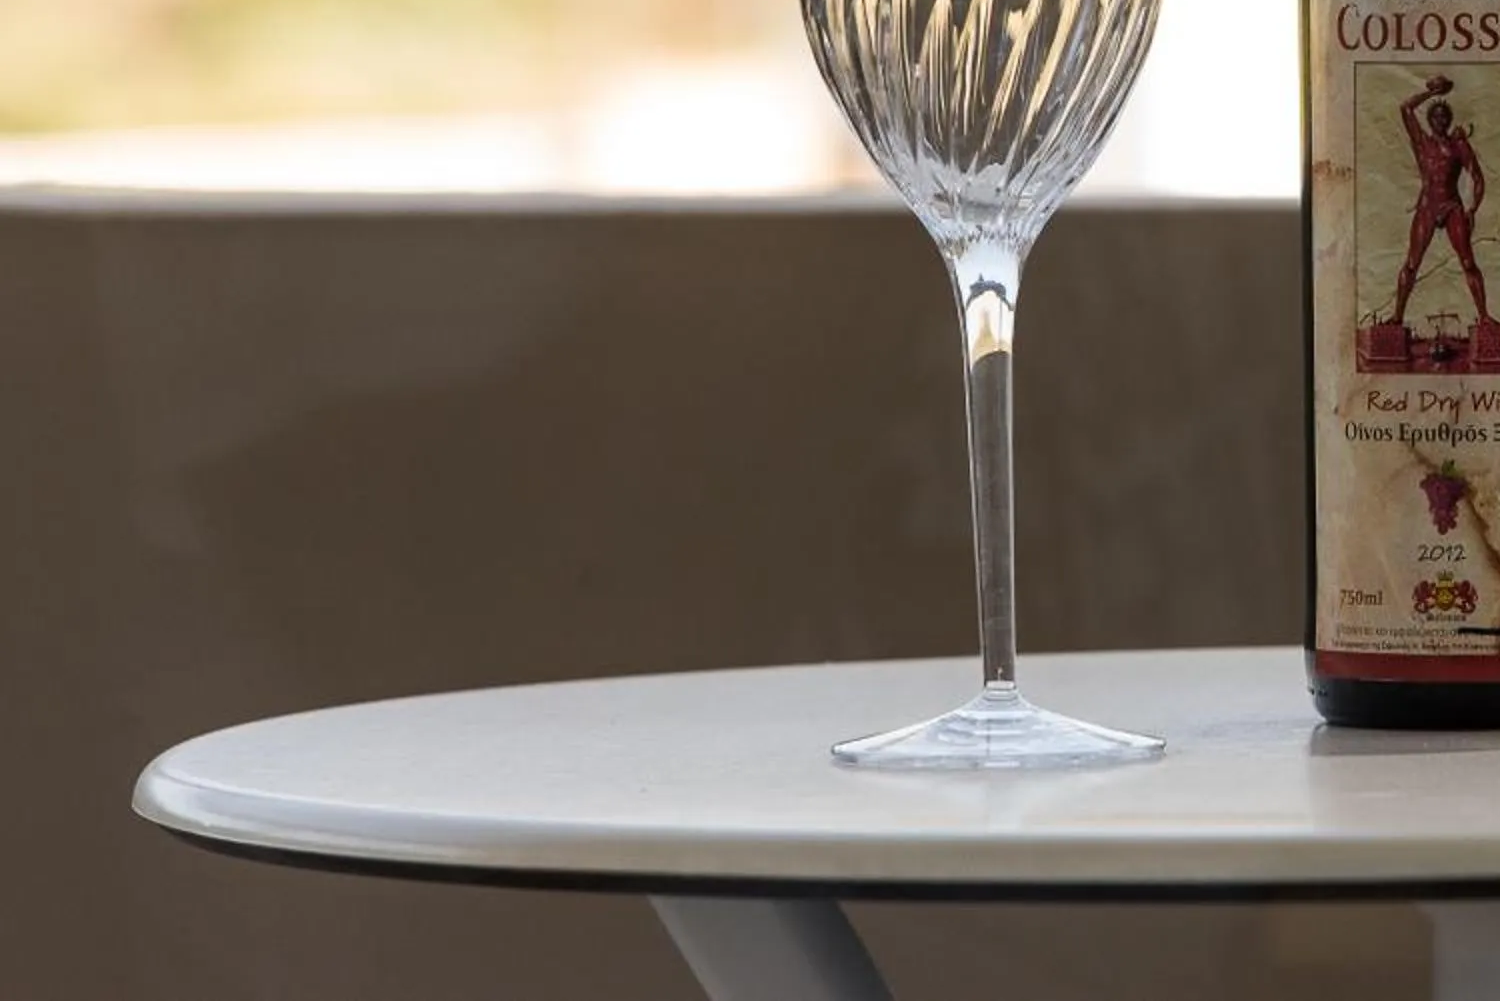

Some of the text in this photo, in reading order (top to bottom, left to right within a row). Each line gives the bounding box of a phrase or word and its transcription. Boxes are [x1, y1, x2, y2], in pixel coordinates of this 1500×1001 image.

[1367, 390, 1409, 412] Red
[1418, 390, 1461, 423] Dry
[1345, 421, 1393, 442] Οίνος
[1399, 421, 1488, 447] Ερυθρός
[1418, 544, 1467, 562] 2012
[1340, 589, 1383, 608] 750ml
